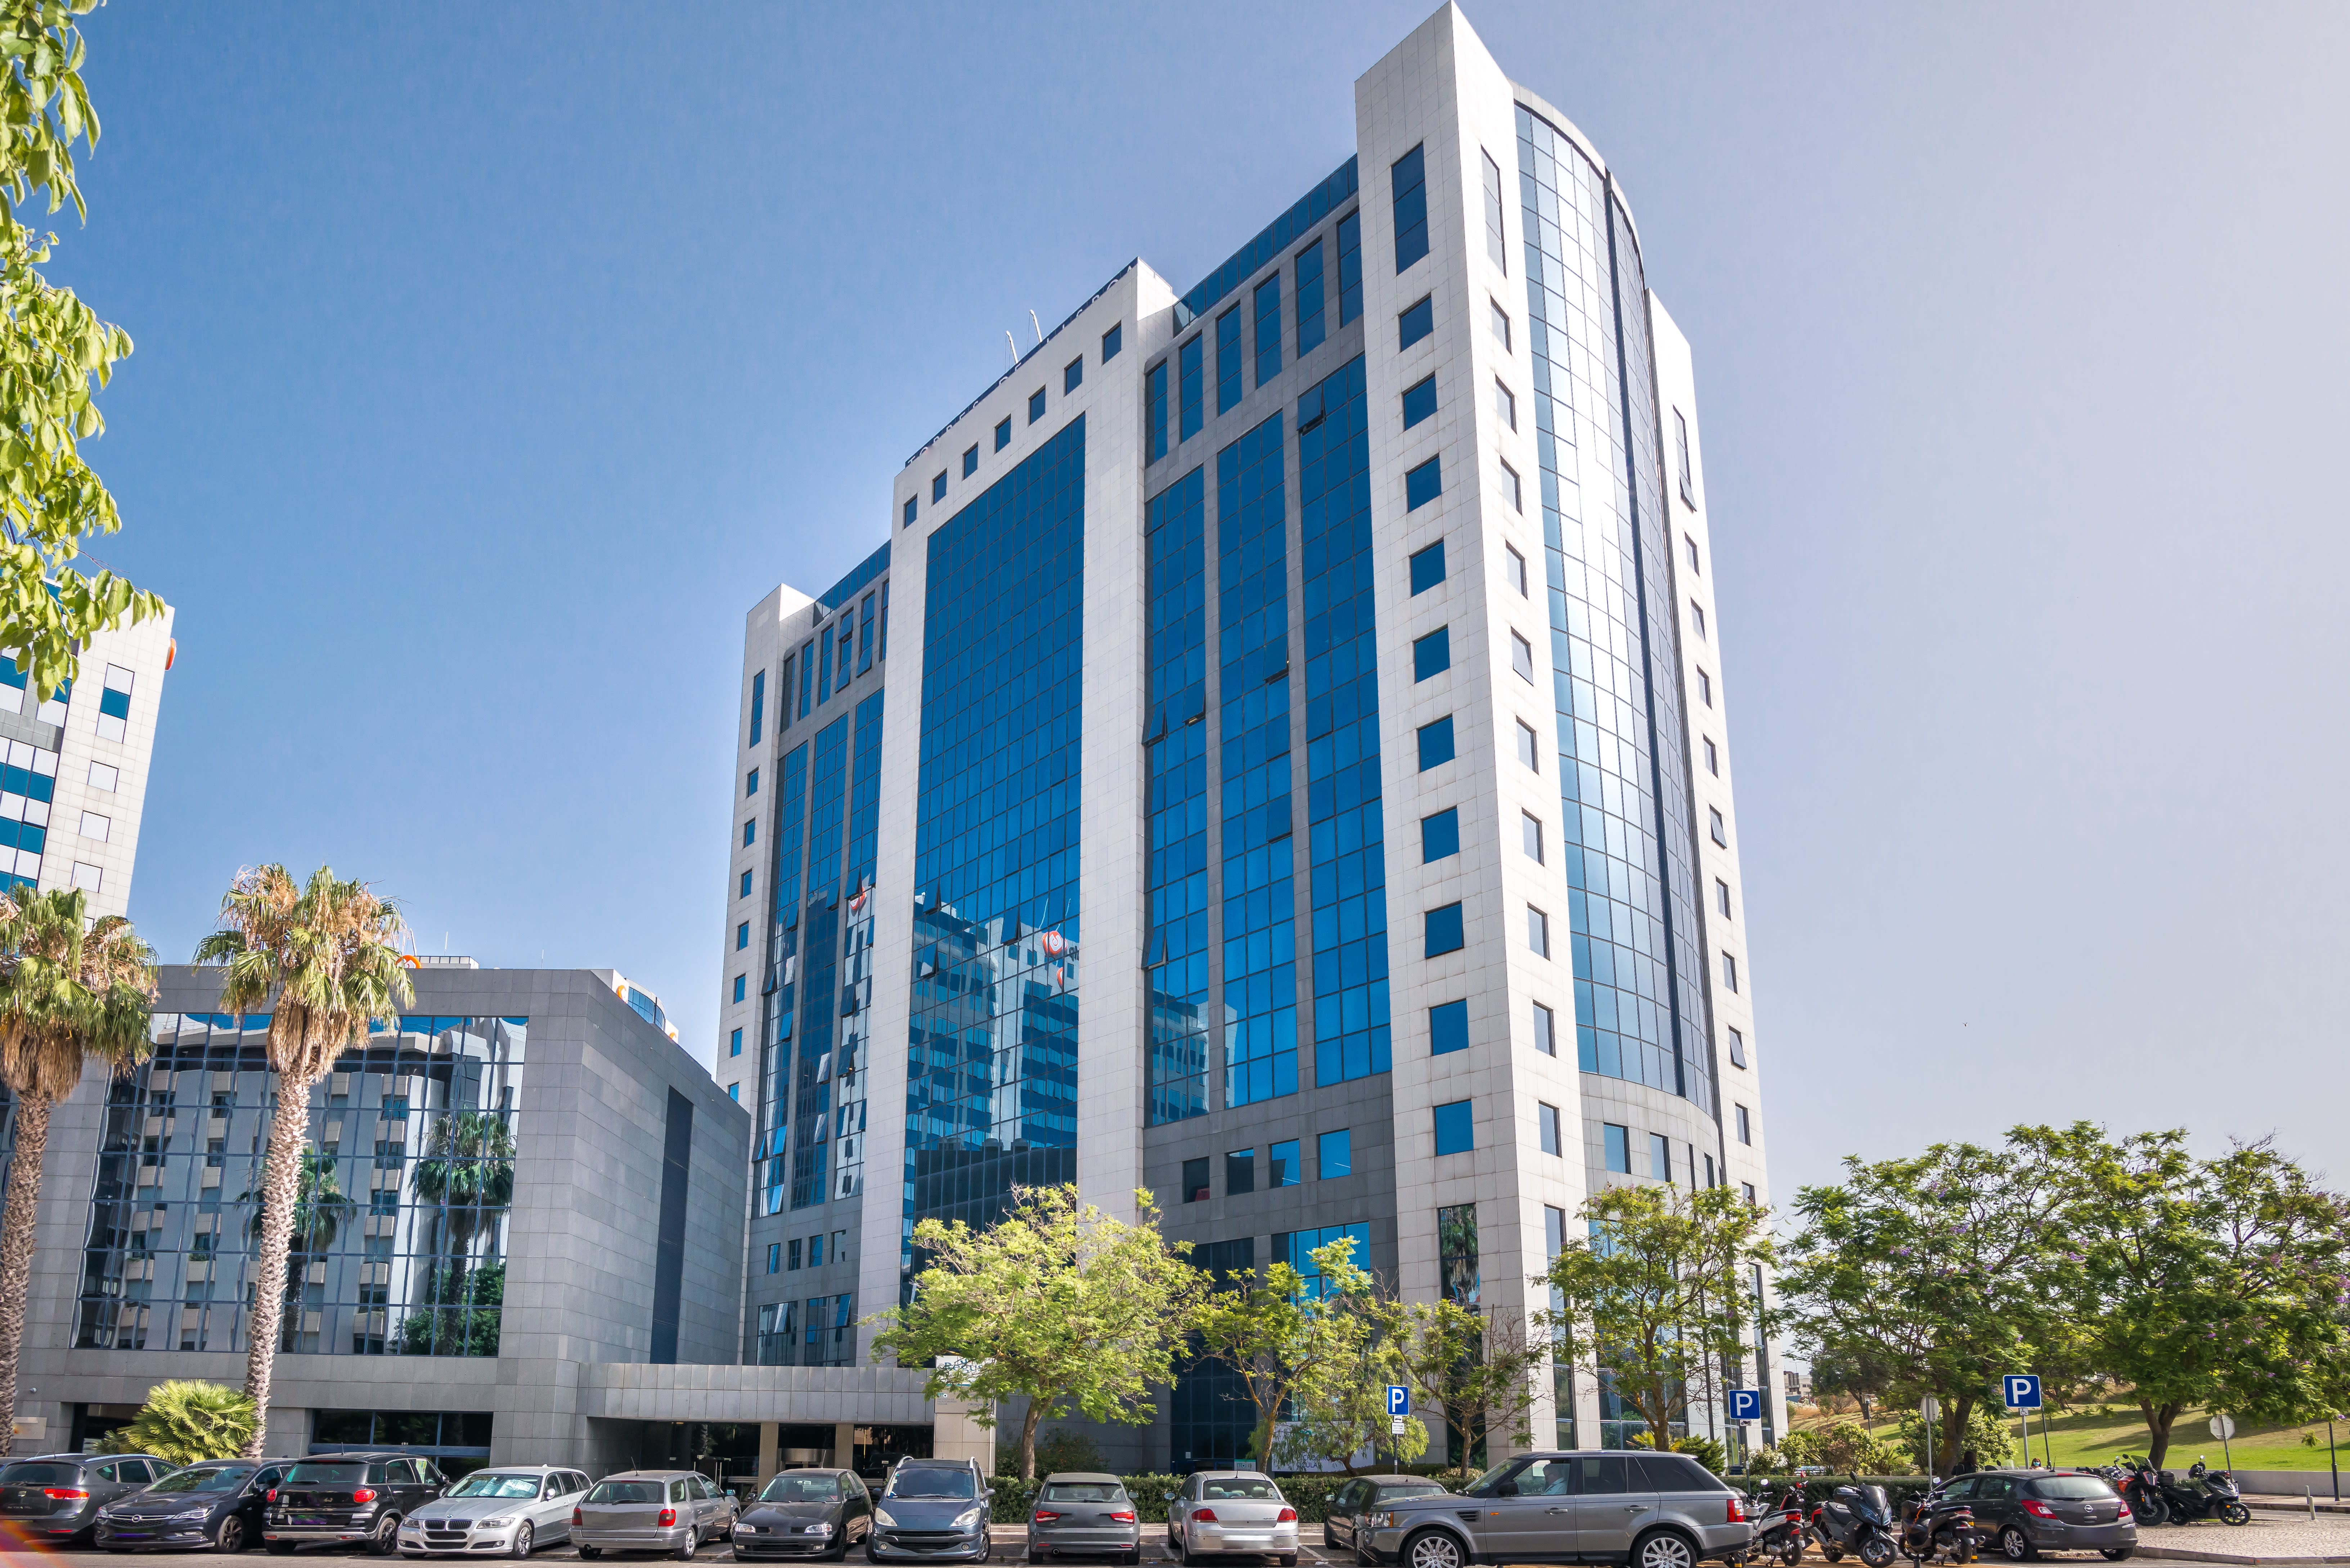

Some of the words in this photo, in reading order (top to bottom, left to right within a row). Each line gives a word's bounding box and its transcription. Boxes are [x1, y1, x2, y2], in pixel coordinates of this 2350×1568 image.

[1392, 1388, 1404, 1412] P
[2012, 1379, 2031, 1403] P
[1736, 1393, 1753, 1416] P
